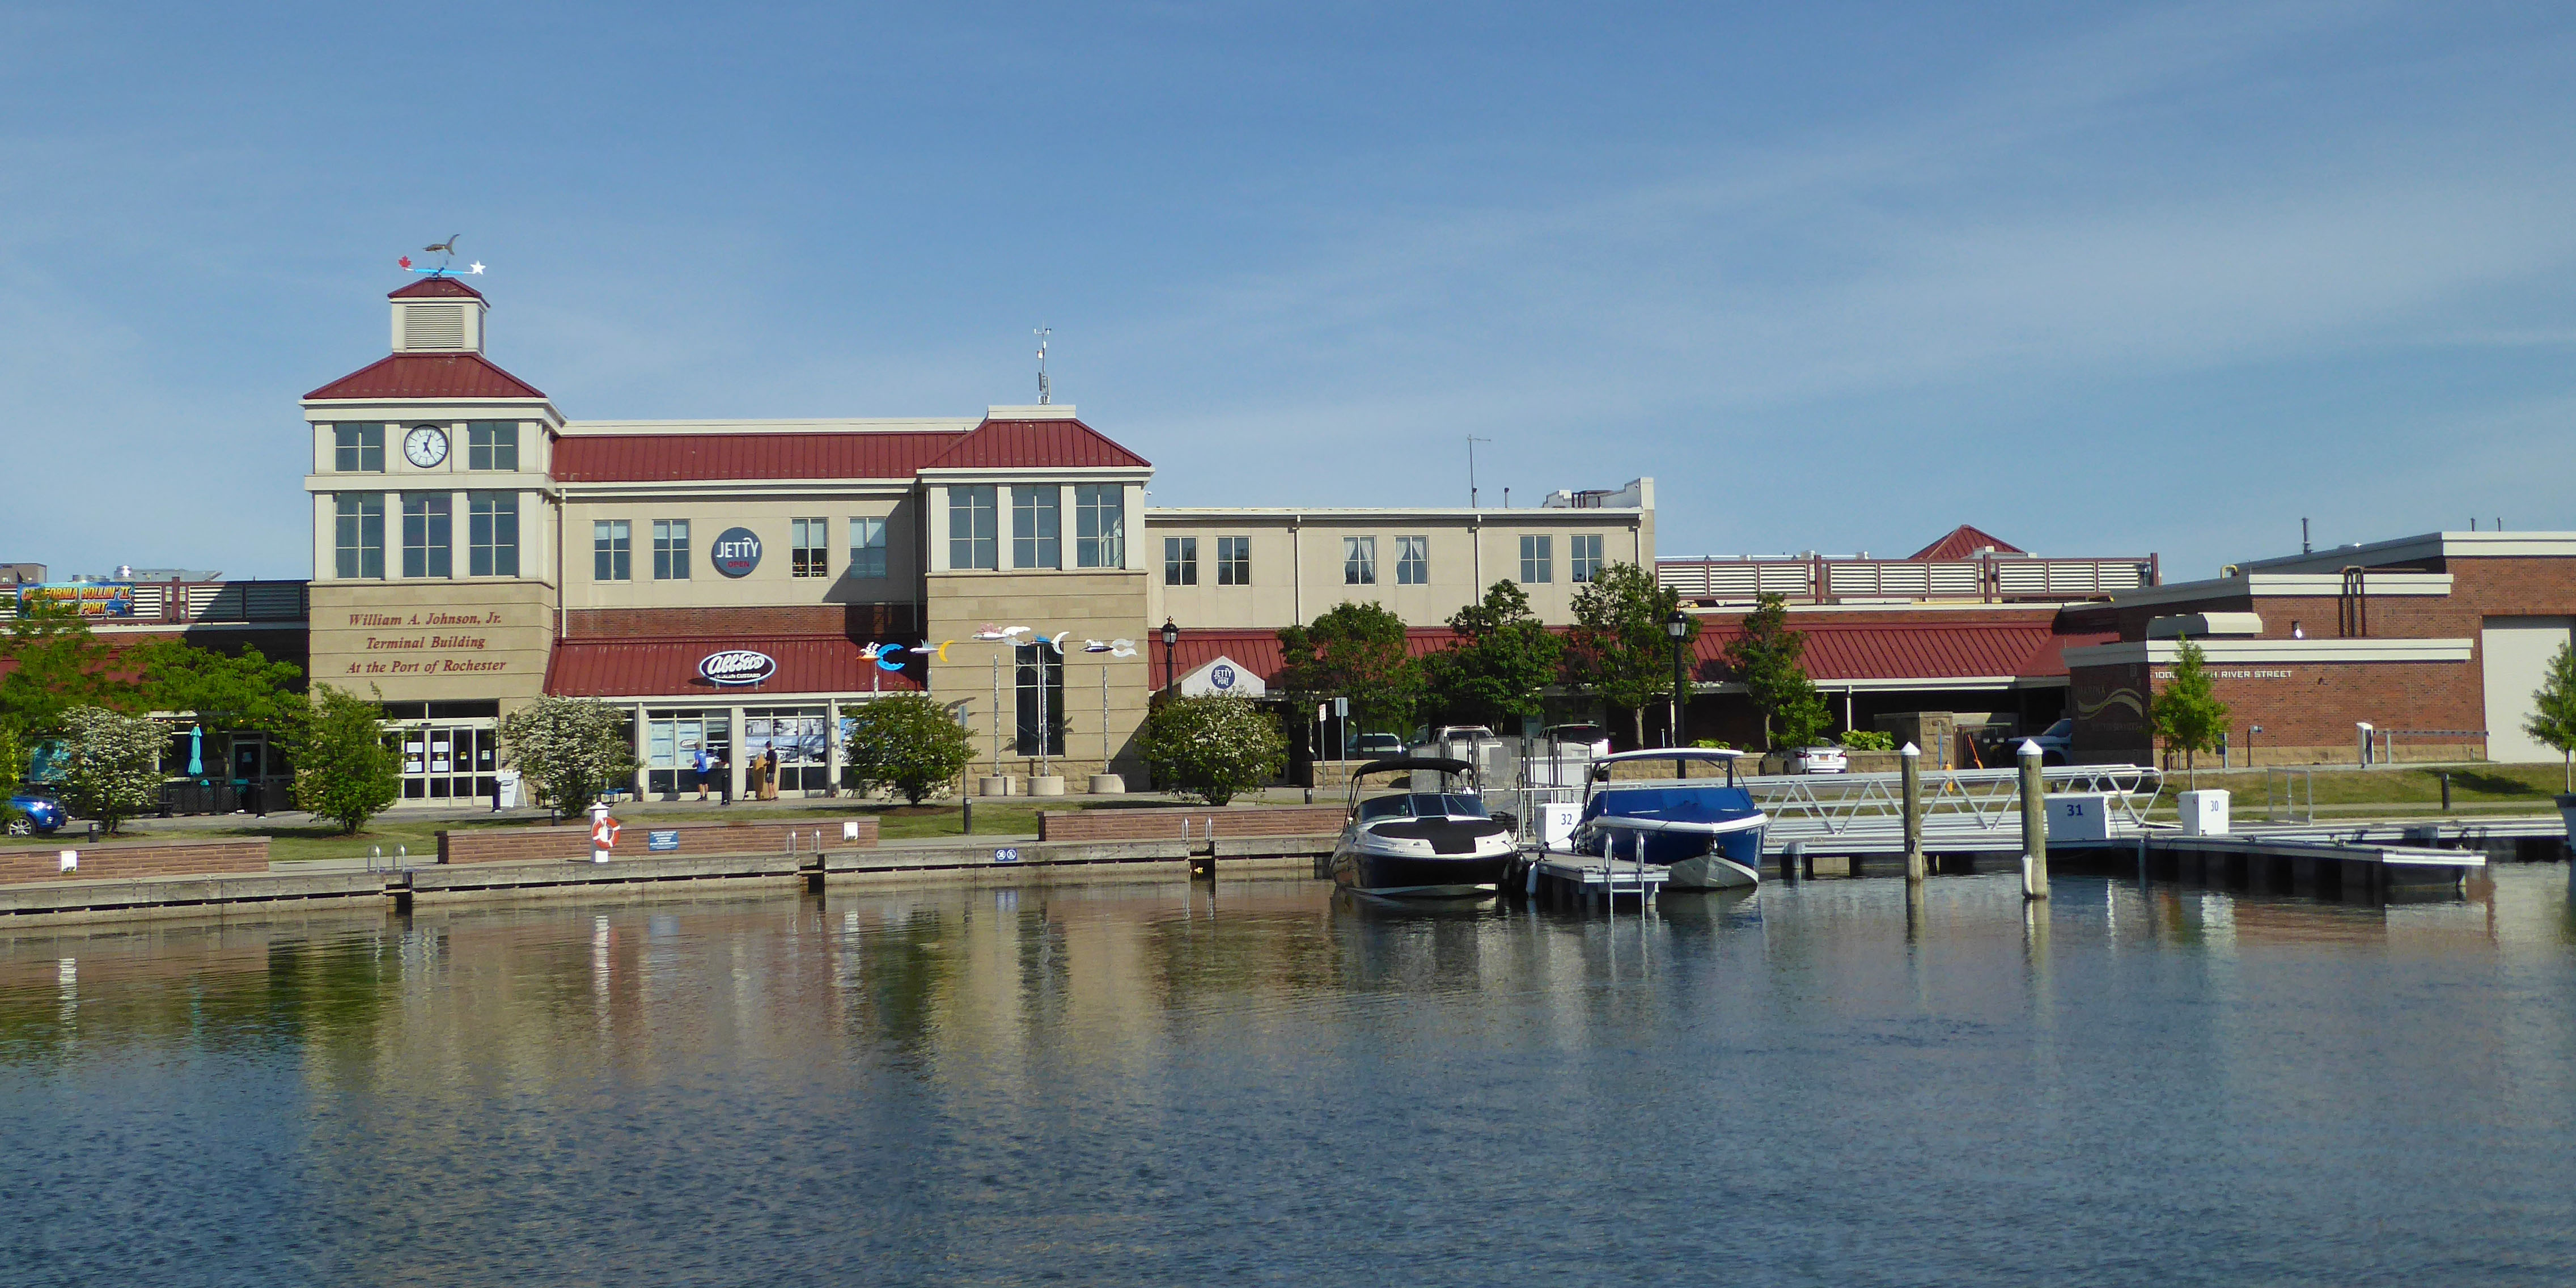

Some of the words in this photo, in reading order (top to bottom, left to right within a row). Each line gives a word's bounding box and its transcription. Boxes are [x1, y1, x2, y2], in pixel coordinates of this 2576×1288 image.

[716, 537, 759, 558] JETTY
[81, 602, 108, 615] PORT
[349, 613, 402, 626] William
[408, 613, 420, 625] A.
[426, 612, 481, 625] Johnson,
[486, 612, 501, 624] Jr.
[366, 637, 425, 649] Terminal
[431, 635, 485, 649] Building
[346, 662, 362, 673] At
[366, 661, 386, 672] the
[391, 660, 420, 672] Port
[425, 660, 439, 674] of
[443, 659, 506, 672] Rochester
[1214, 668, 1232, 677] JETTY
[1218, 677, 1229, 686] PORT
[2067, 804, 2083, 816] 31
[2210, 800, 2219, 812] 30
[1561, 814, 1572, 825] 32
